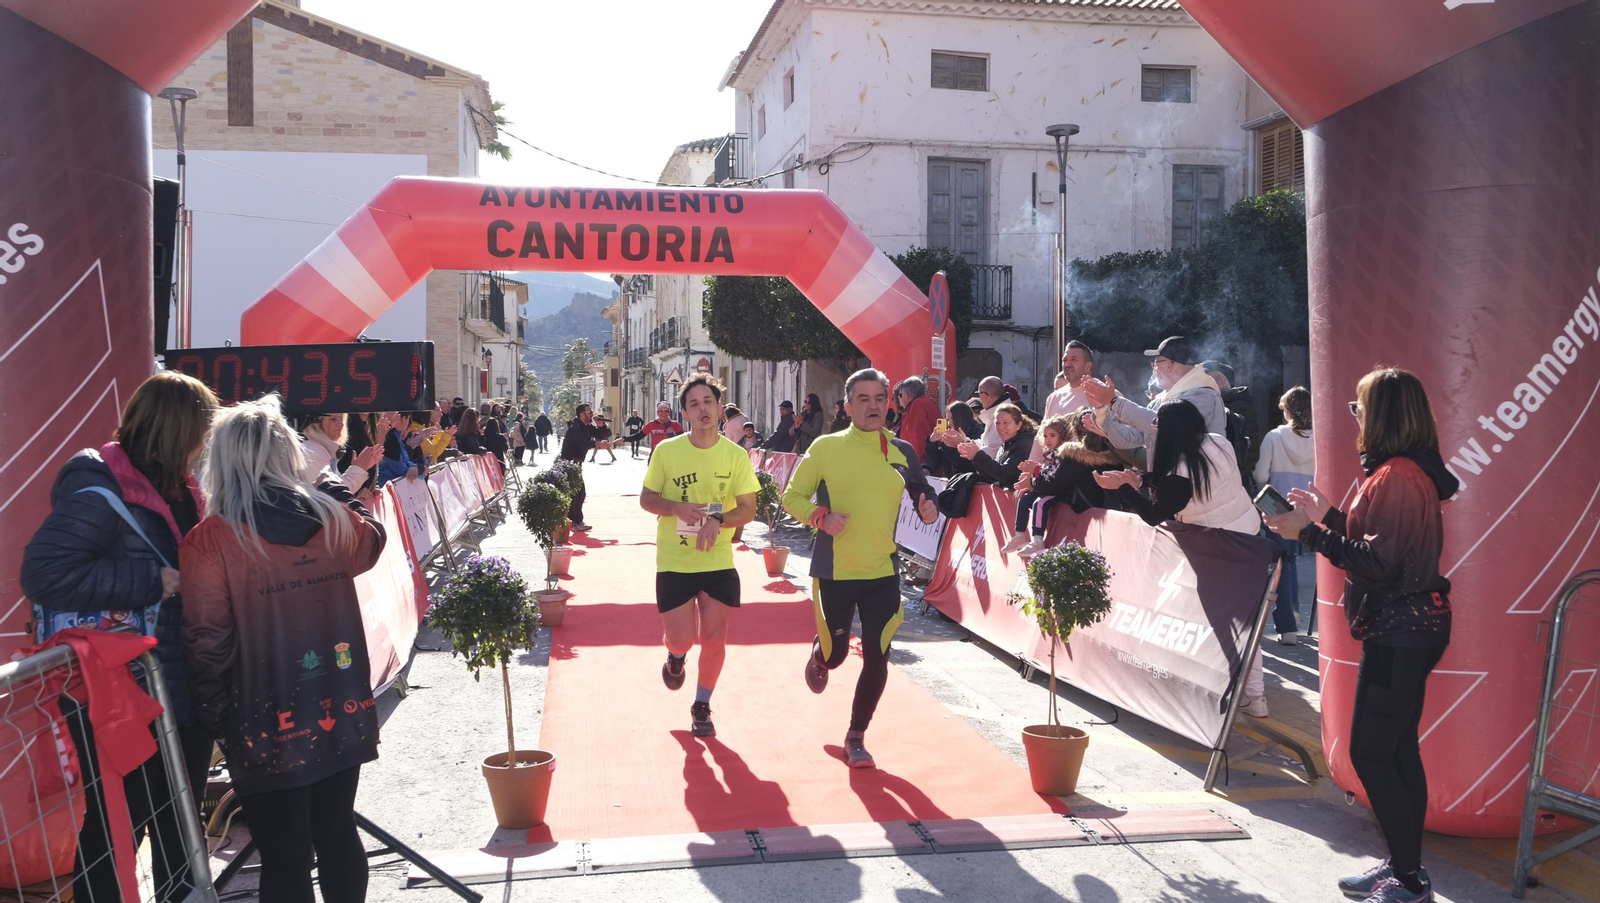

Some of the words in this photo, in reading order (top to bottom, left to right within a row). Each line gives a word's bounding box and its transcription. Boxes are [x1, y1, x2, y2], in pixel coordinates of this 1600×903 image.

[479, 184, 744, 214] AYUNTAMIENTO
[487, 219, 735, 263] CANTORIA
[672, 472, 698, 488] VIII
[258, 583, 286, 596] VALLE
[290, 579, 302, 589] DE
[1108, 601, 1214, 656] TEAMERGY
